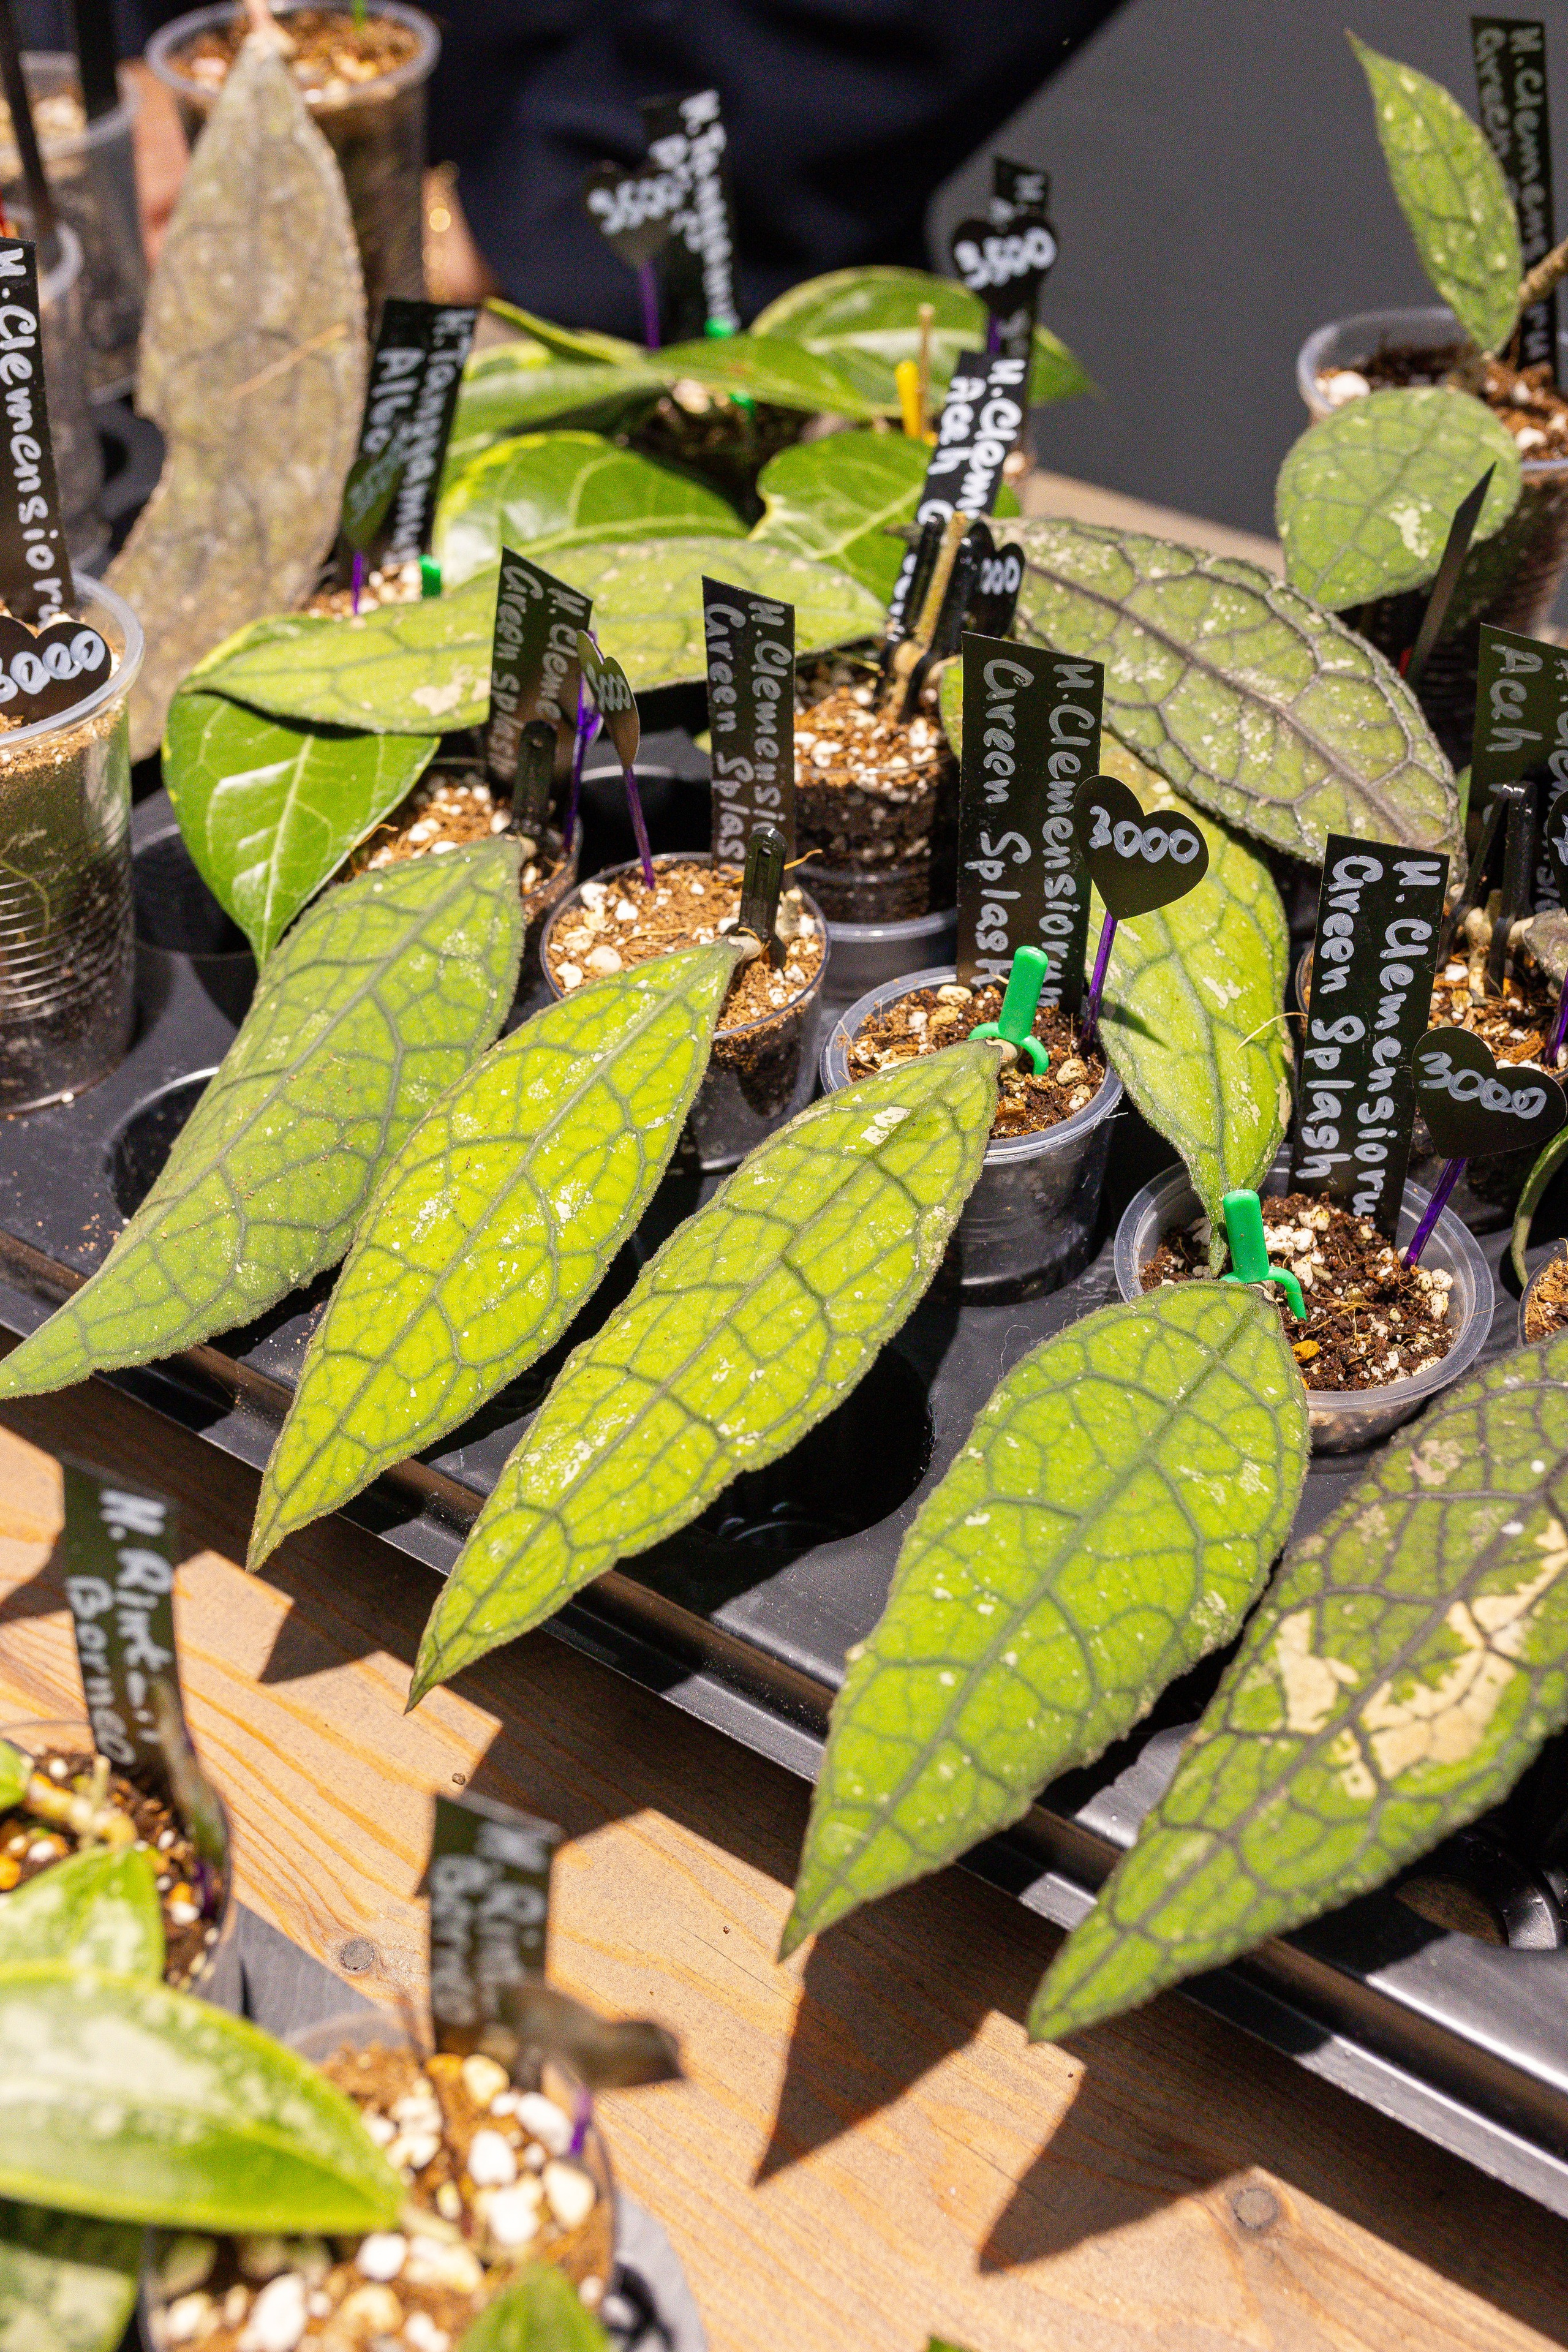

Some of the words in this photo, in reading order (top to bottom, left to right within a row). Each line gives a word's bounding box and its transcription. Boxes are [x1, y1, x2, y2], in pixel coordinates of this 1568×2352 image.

[495, 565, 544, 661] Green
[704, 603, 747, 733] Green
[982, 658, 1035, 804] Green
[1088, 805, 1200, 864] 3000
[1320, 855, 1384, 994] Green
[1295, 1015, 1366, 1180] Splash
[1352, 918, 1433, 1230] Clemensioru
[1419, 1051, 1547, 1120] 3000
